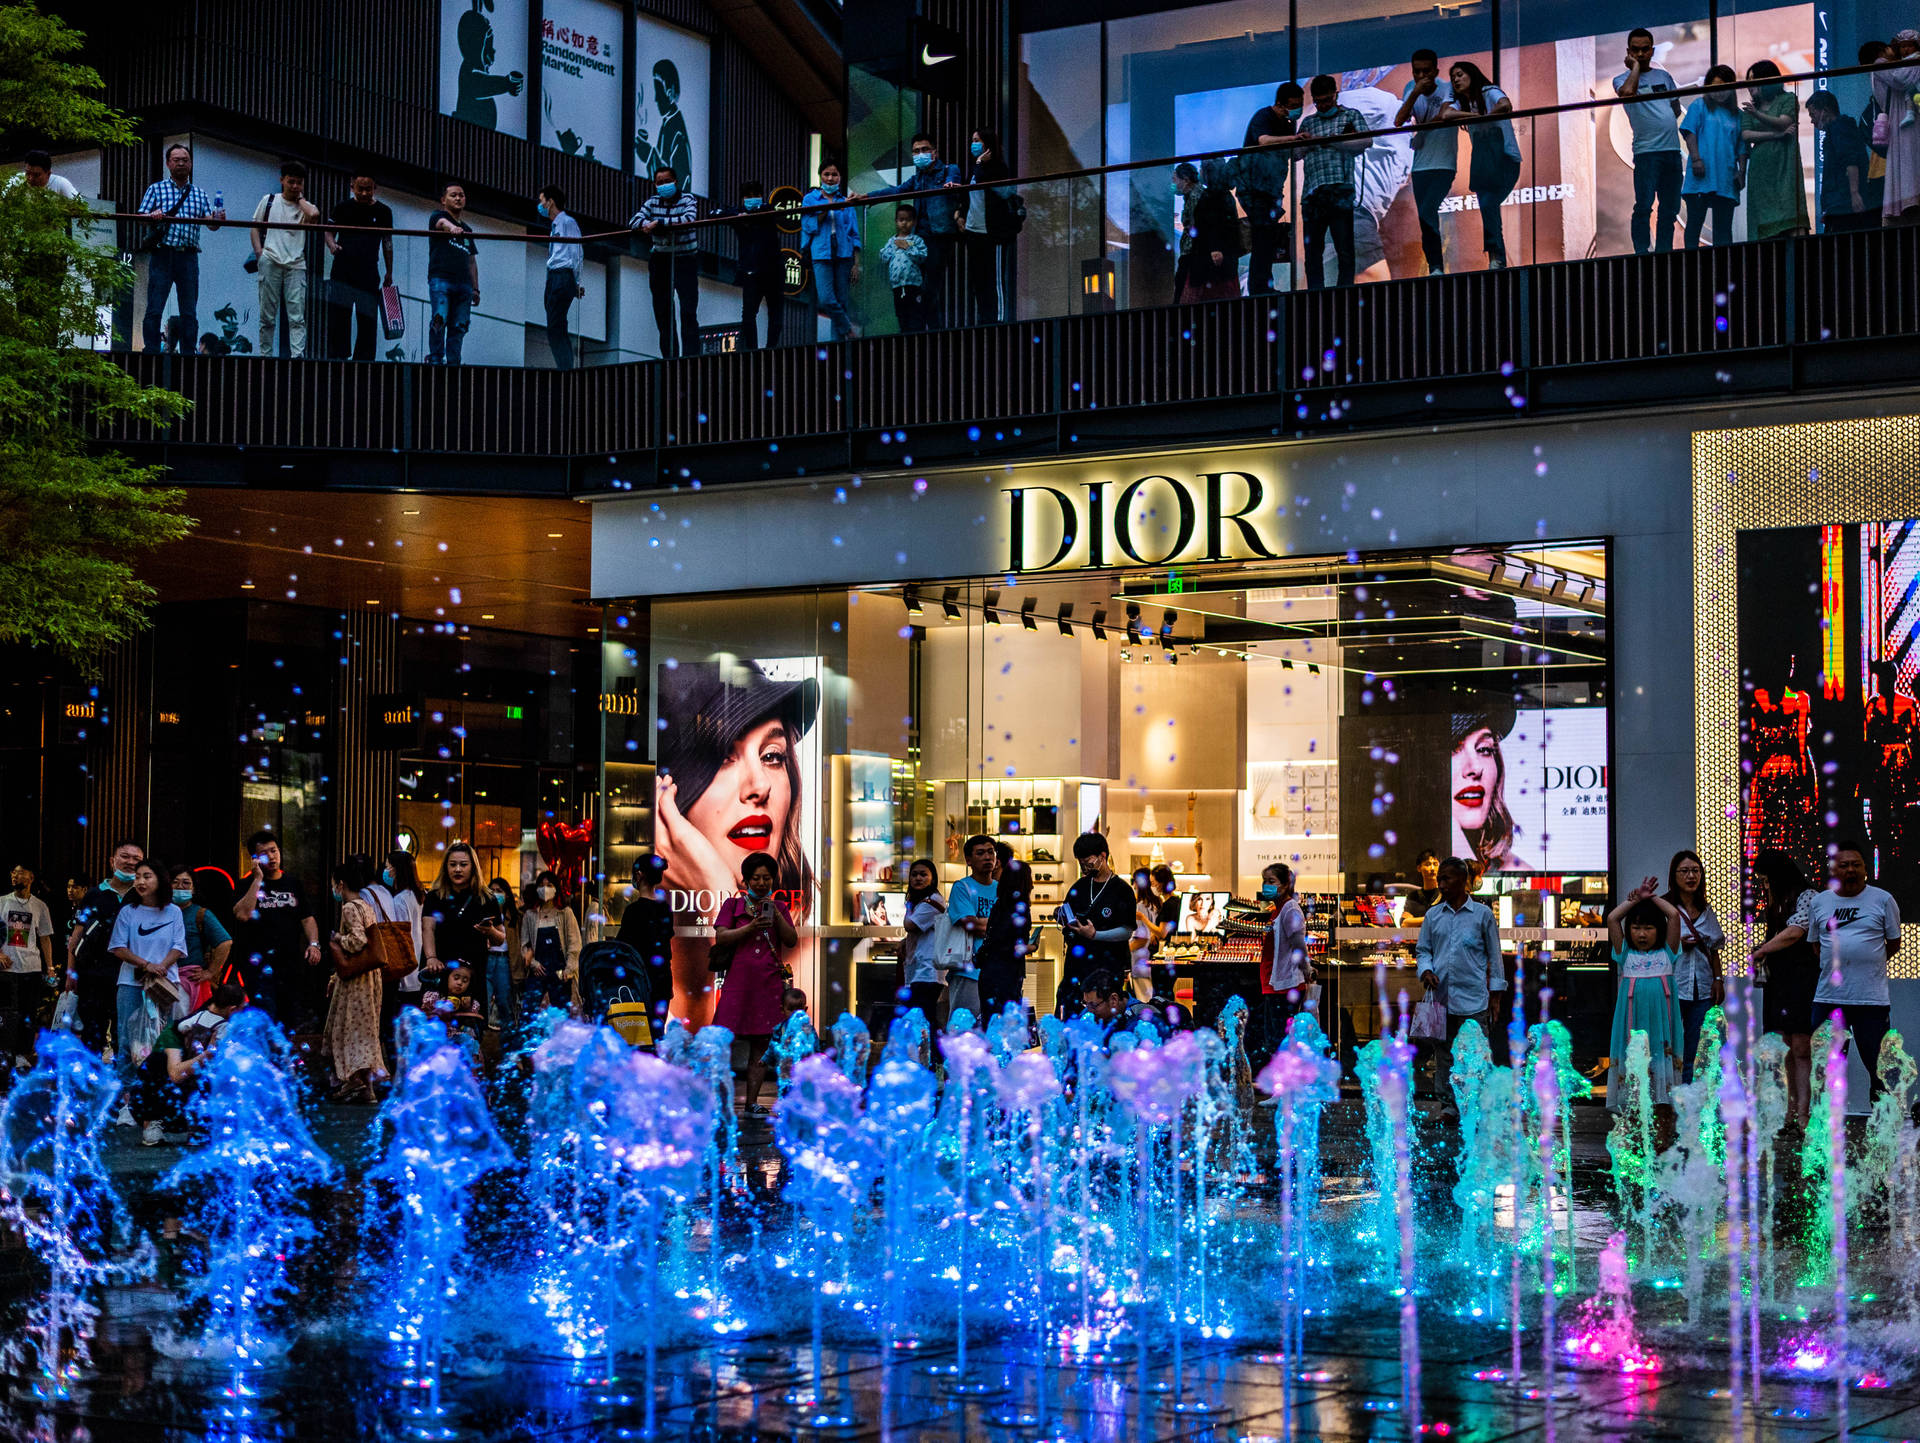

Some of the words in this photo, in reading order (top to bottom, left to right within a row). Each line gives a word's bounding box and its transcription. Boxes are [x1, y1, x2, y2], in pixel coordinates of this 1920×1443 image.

[541, 40, 615, 77] Randomevent
[542, 54, 583, 79] Market.
[1000, 471, 1278, 573] DIOR
[1833, 907, 1860, 920] NIKE
